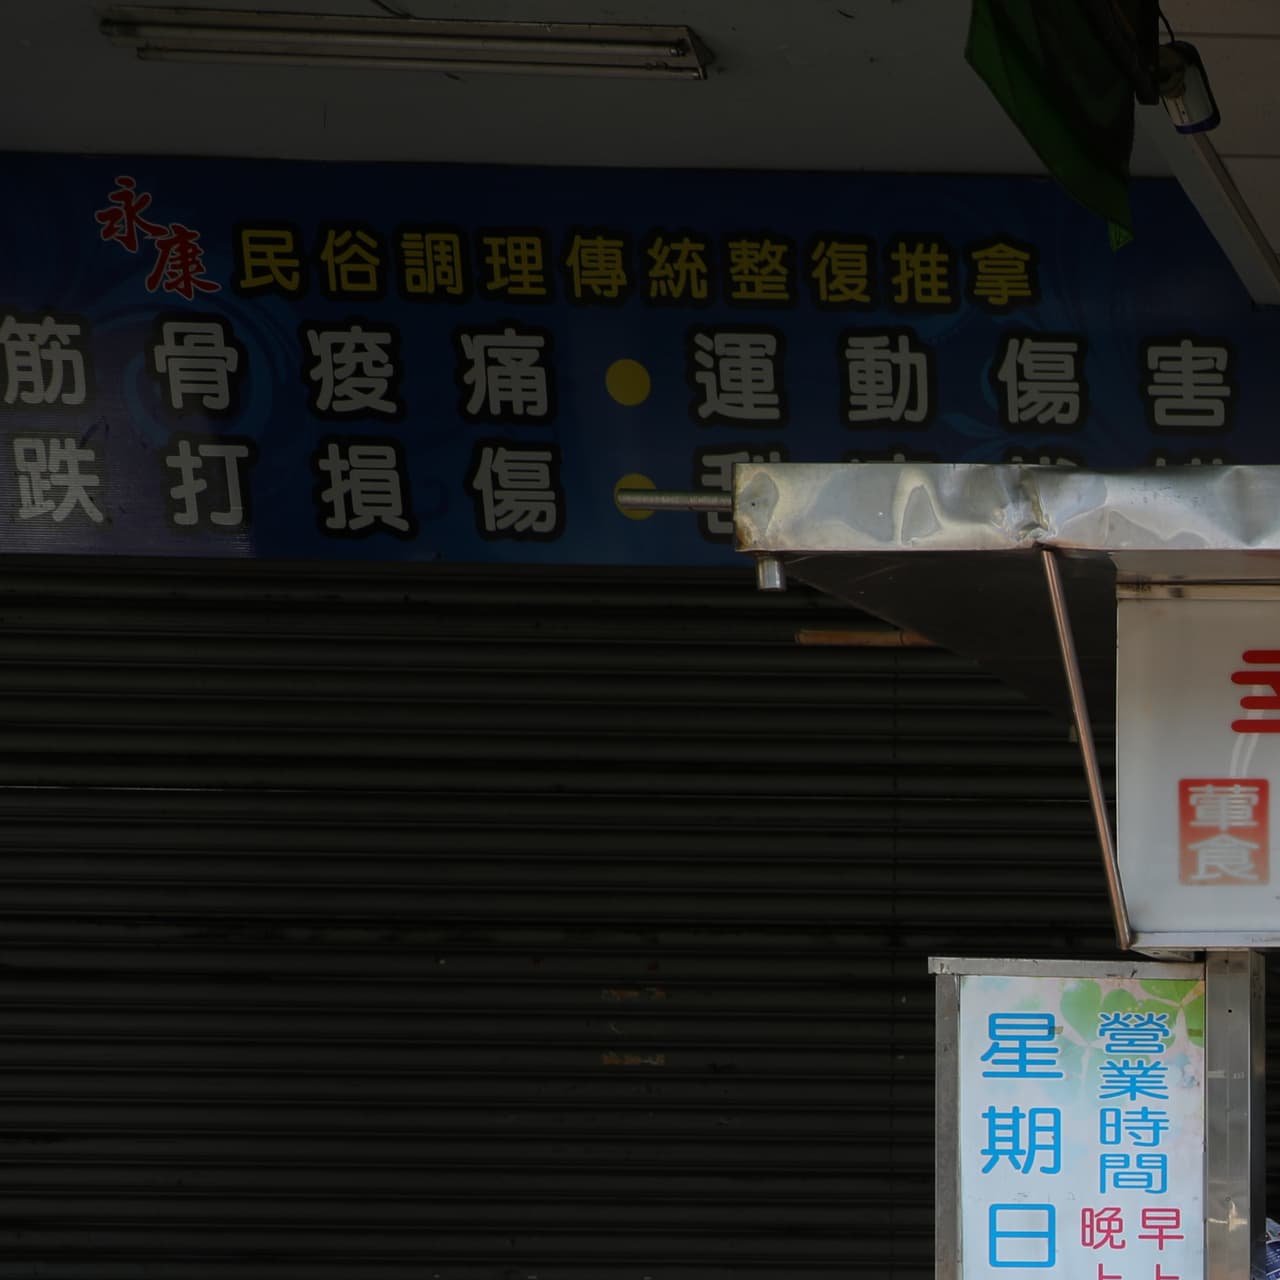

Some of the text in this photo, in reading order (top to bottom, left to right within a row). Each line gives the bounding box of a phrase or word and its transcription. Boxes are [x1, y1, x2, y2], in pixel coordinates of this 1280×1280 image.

[94, 175, 223, 301] 永康
[239, 226, 1036, 305] 民俗調理傳統整復推拿
[0, 314, 1233, 427] 筋骨痠痛 運動傷害
[13, 437, 558, 535] 跌打損傷
[1187, 784, 1264, 883] 葷食
[1097, 1012, 1170, 1194] 營業時間
